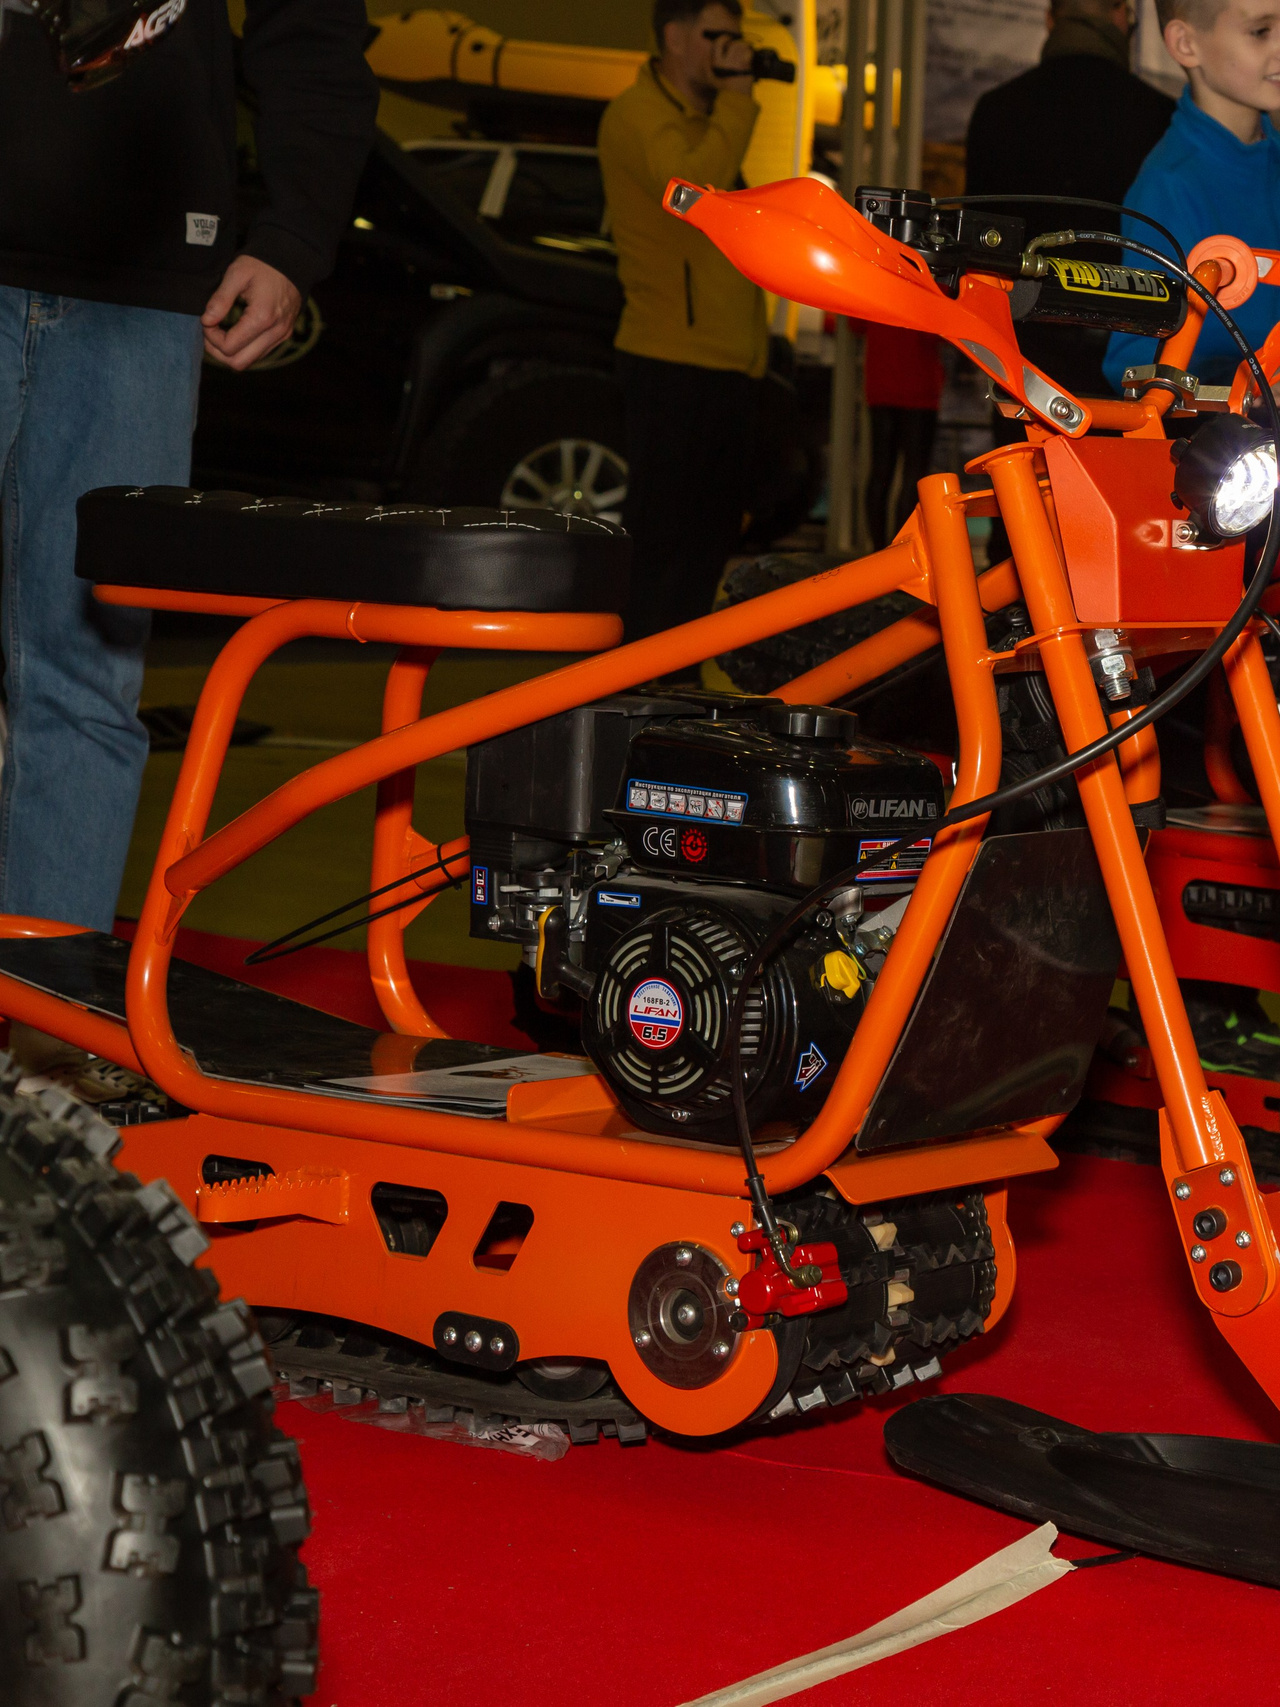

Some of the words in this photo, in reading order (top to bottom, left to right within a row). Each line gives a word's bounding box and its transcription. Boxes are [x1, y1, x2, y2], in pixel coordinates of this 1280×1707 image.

[868, 799, 925, 818] LIFAN
[642, 826, 676, 857] CE
[643, 996, 670, 1006] 168FB-2
[633, 1005, 678, 1018] LIFAN
[642, 1026, 668, 1042] 6.5
